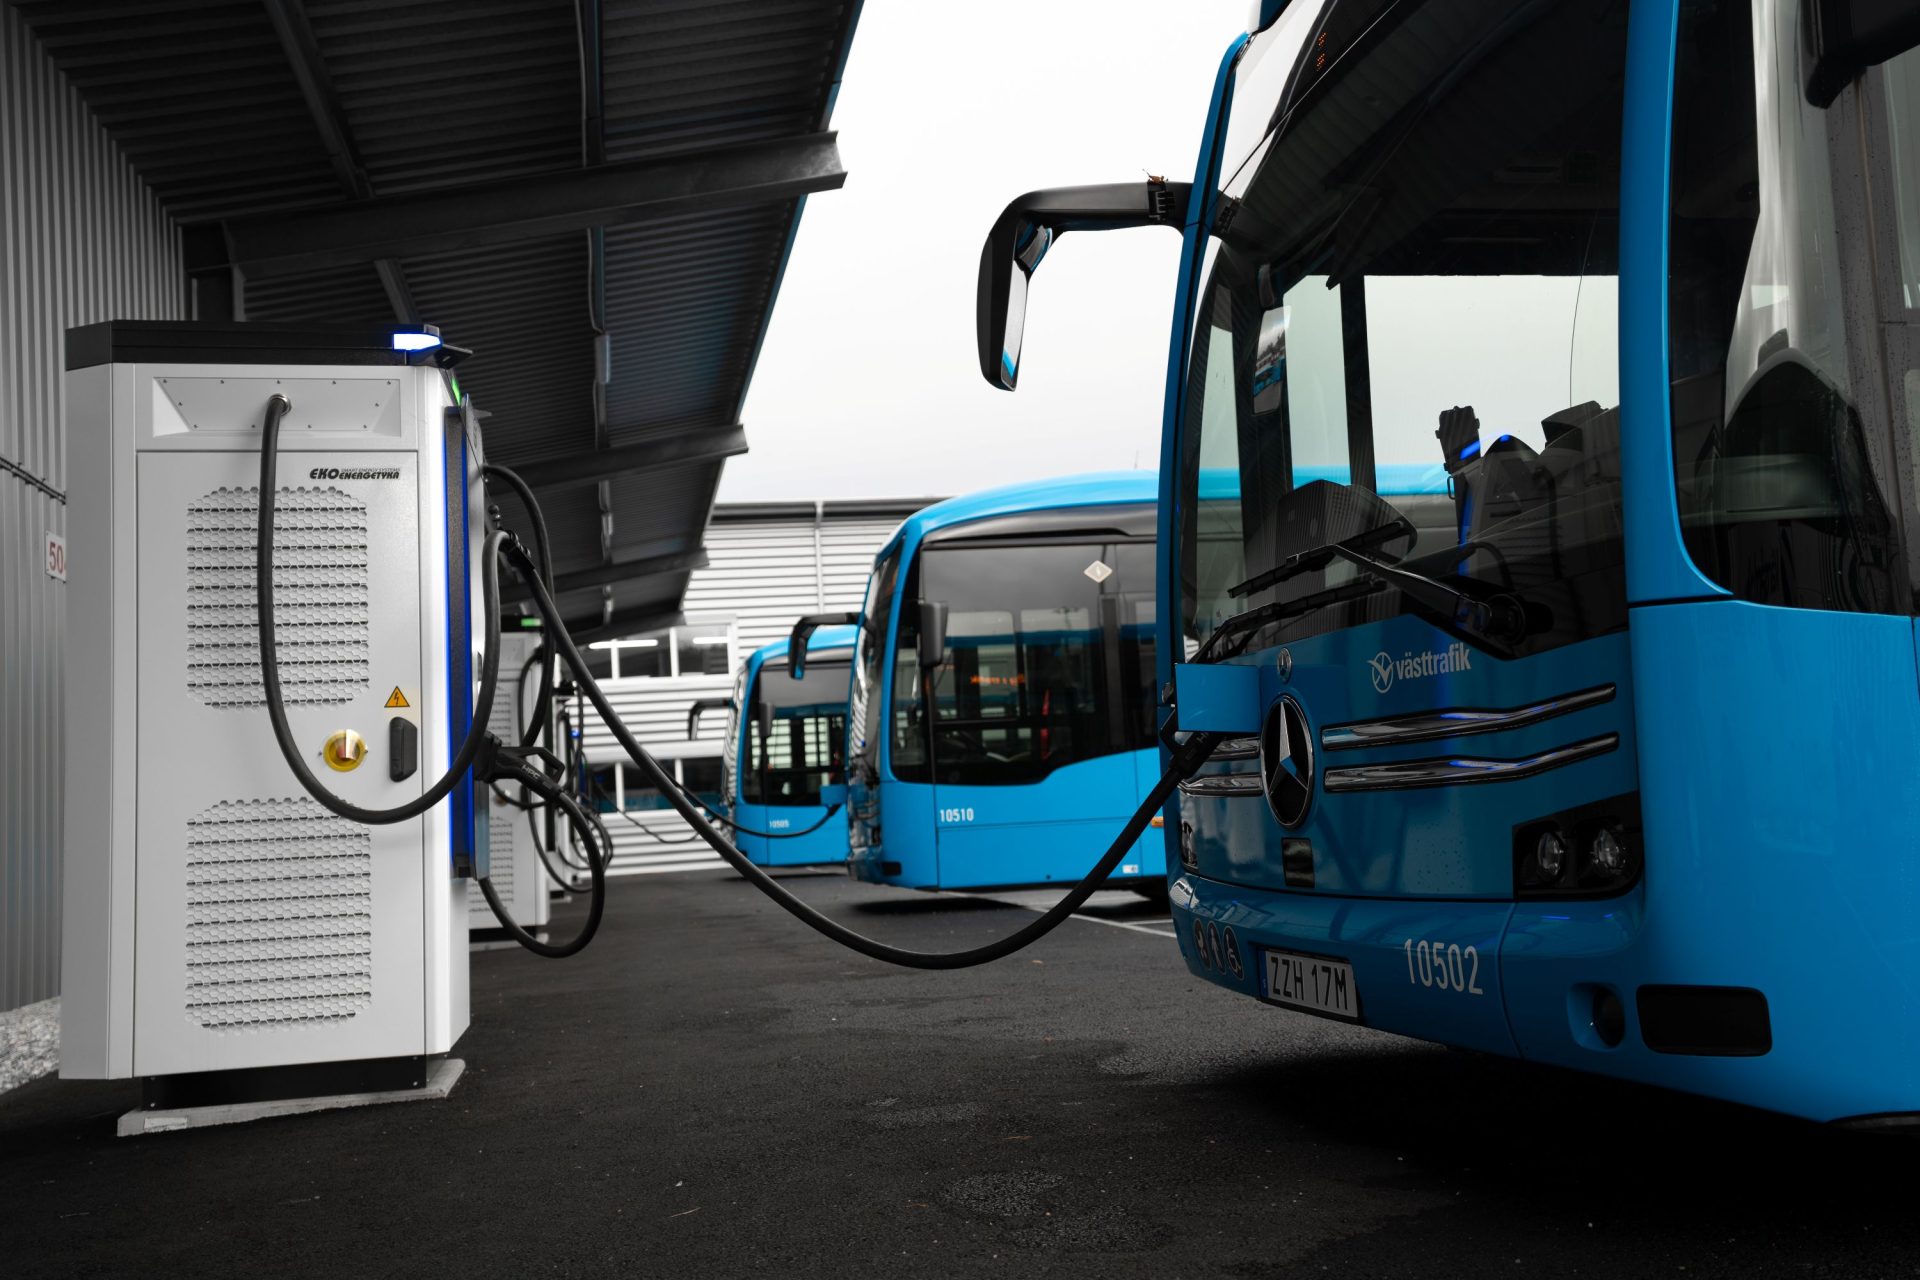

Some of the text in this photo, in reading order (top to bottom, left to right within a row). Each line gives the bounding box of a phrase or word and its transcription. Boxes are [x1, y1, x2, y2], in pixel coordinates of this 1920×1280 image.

[309, 468, 399, 480] EKO ENERGETYKA
[49, 541, 66, 575] 50
[1396, 642, 1471, 680] västtrafik
[940, 808, 974, 822] 10510
[1270, 956, 1348, 1010] ZZH 17M
[1404, 938, 1483, 995] 10502
